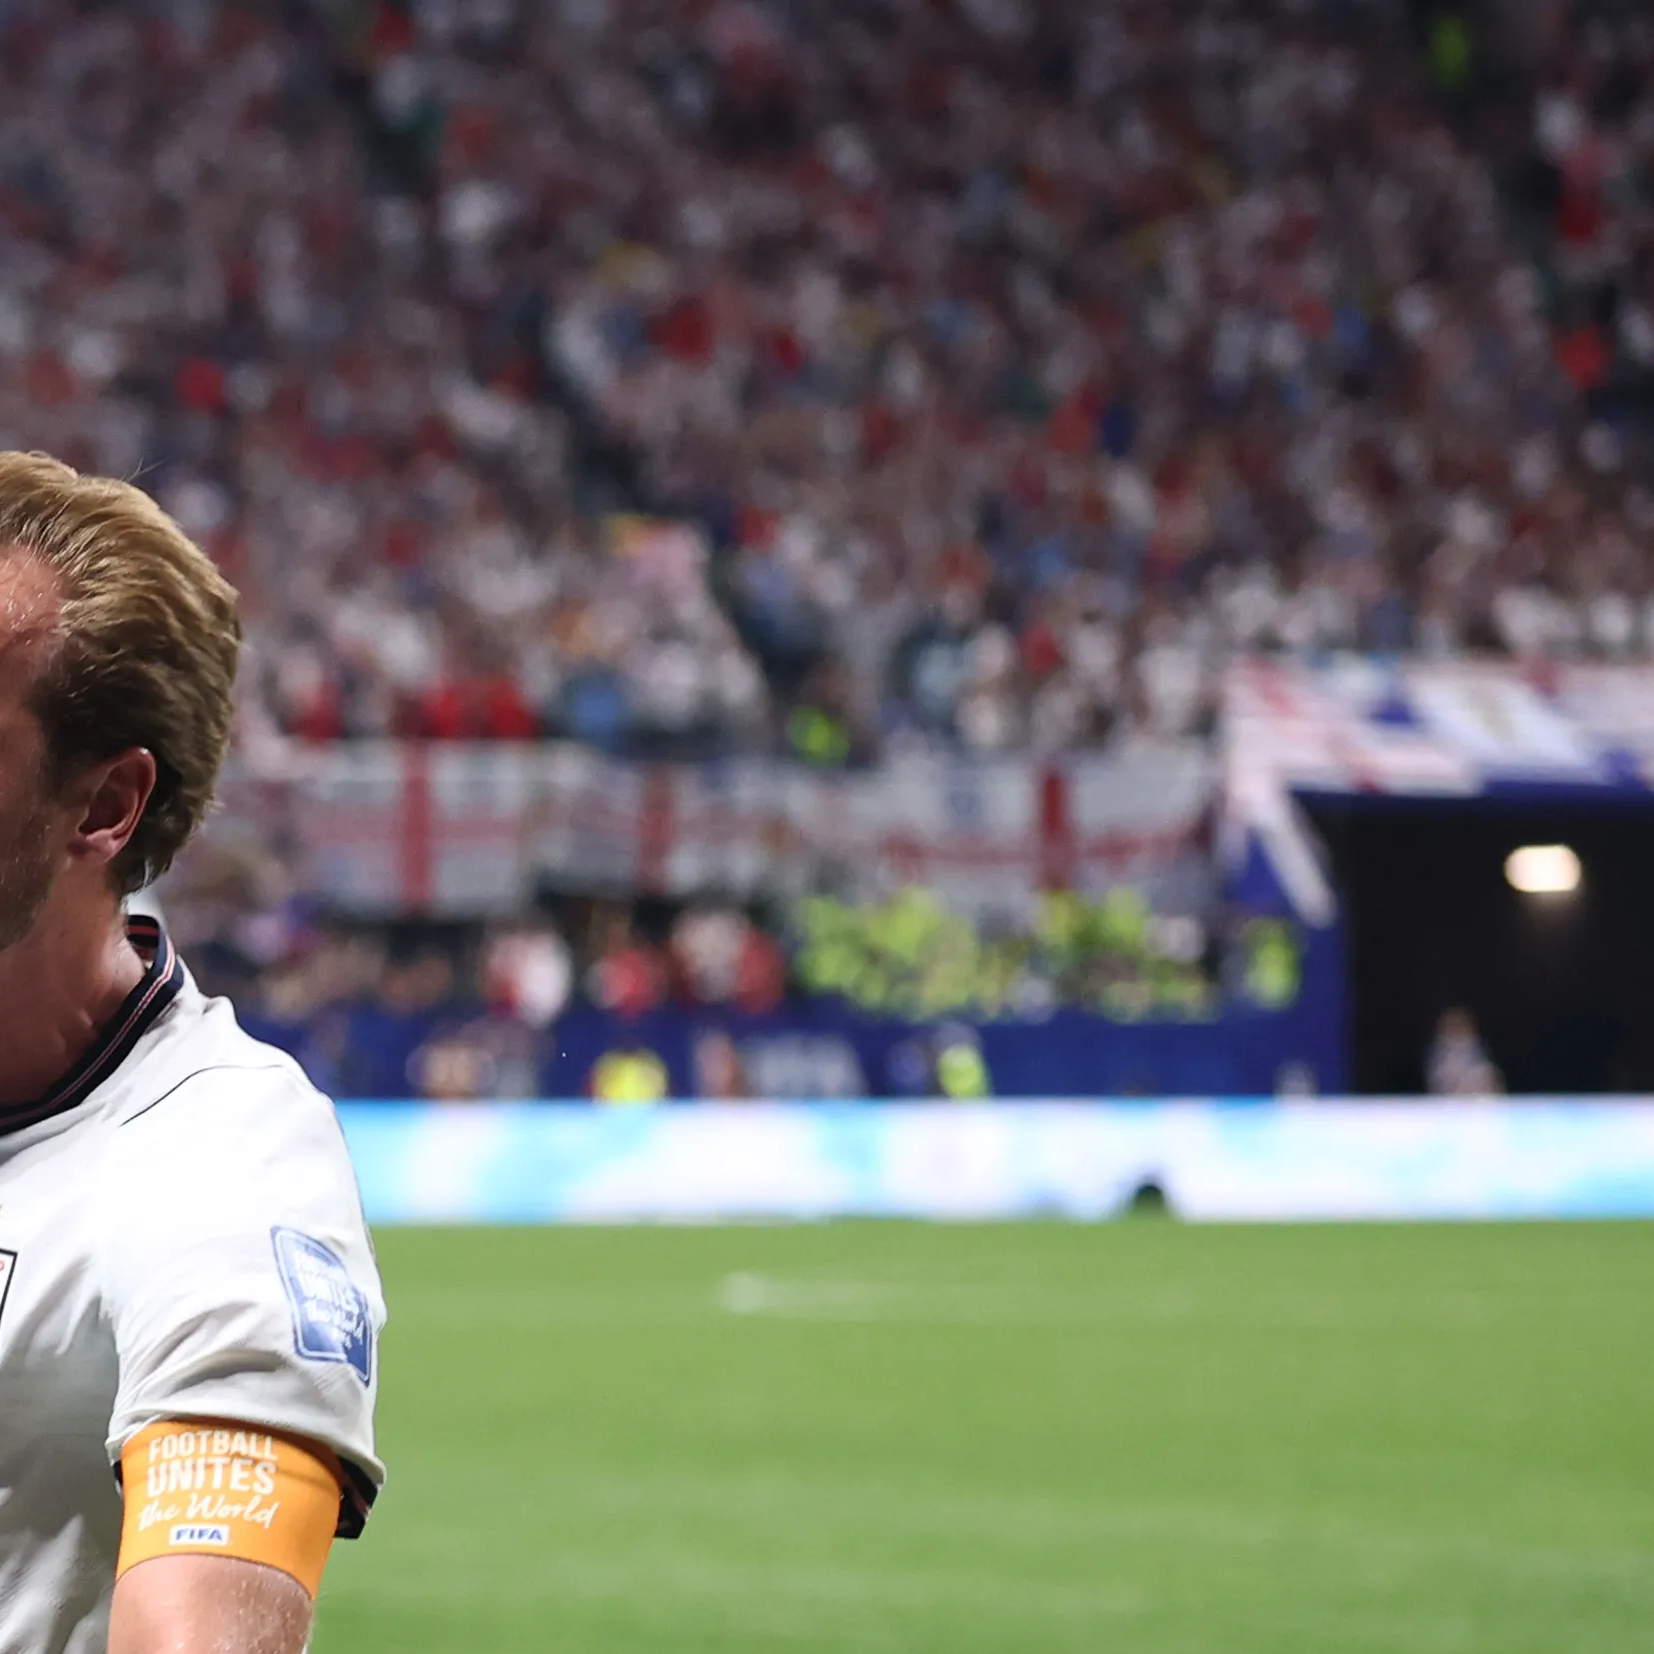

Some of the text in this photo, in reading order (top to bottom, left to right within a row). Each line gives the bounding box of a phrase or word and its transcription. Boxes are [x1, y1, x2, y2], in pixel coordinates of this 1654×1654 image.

[148, 1430, 278, 1464] FOOTBALL
[147, 1456, 277, 1498] UNITES
[138, 1492, 281, 1532] the World
[175, 1528, 224, 1541] FIFA
